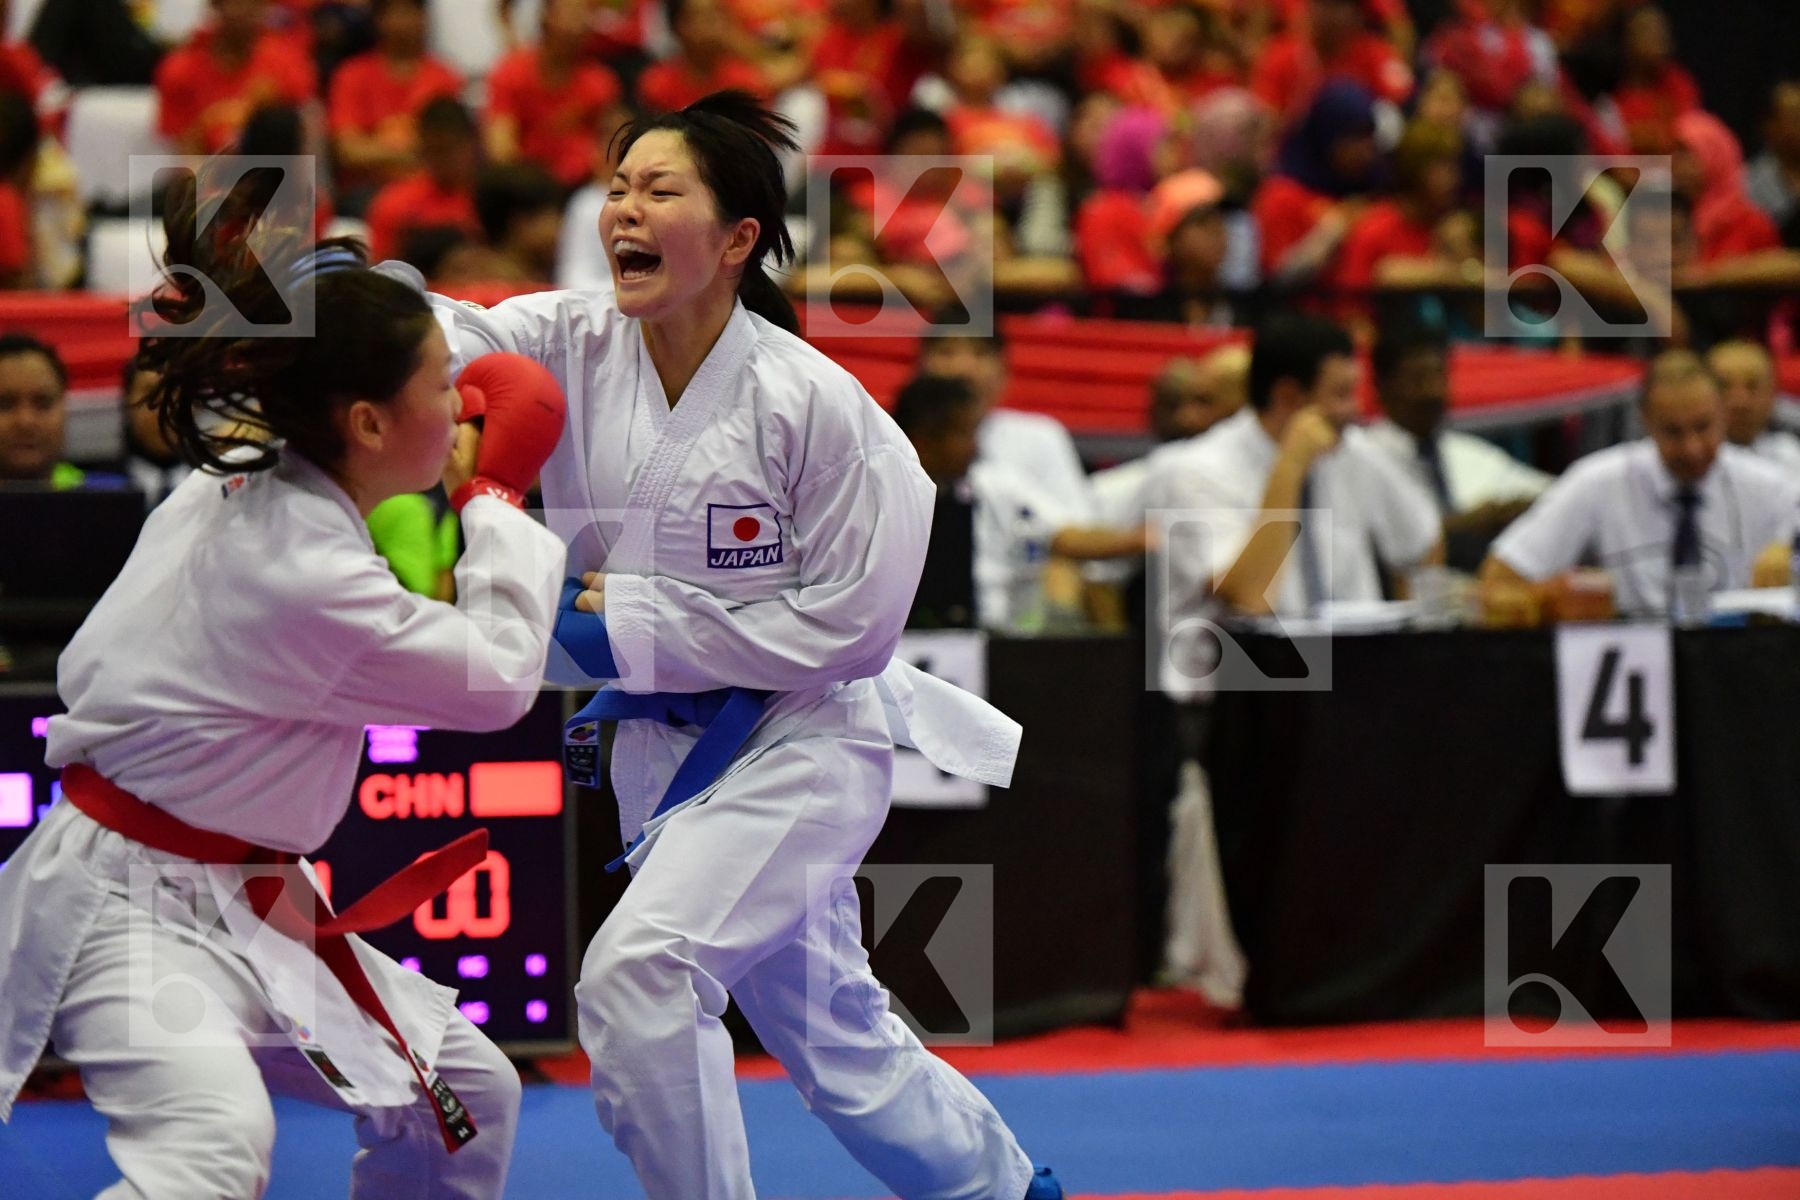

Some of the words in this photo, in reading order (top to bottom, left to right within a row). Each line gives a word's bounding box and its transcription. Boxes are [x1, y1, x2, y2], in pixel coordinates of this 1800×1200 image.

[710, 545, 780, 567] JAPAN
[1582, 648, 1654, 765] 4
[359, 772, 465, 820] CHN
